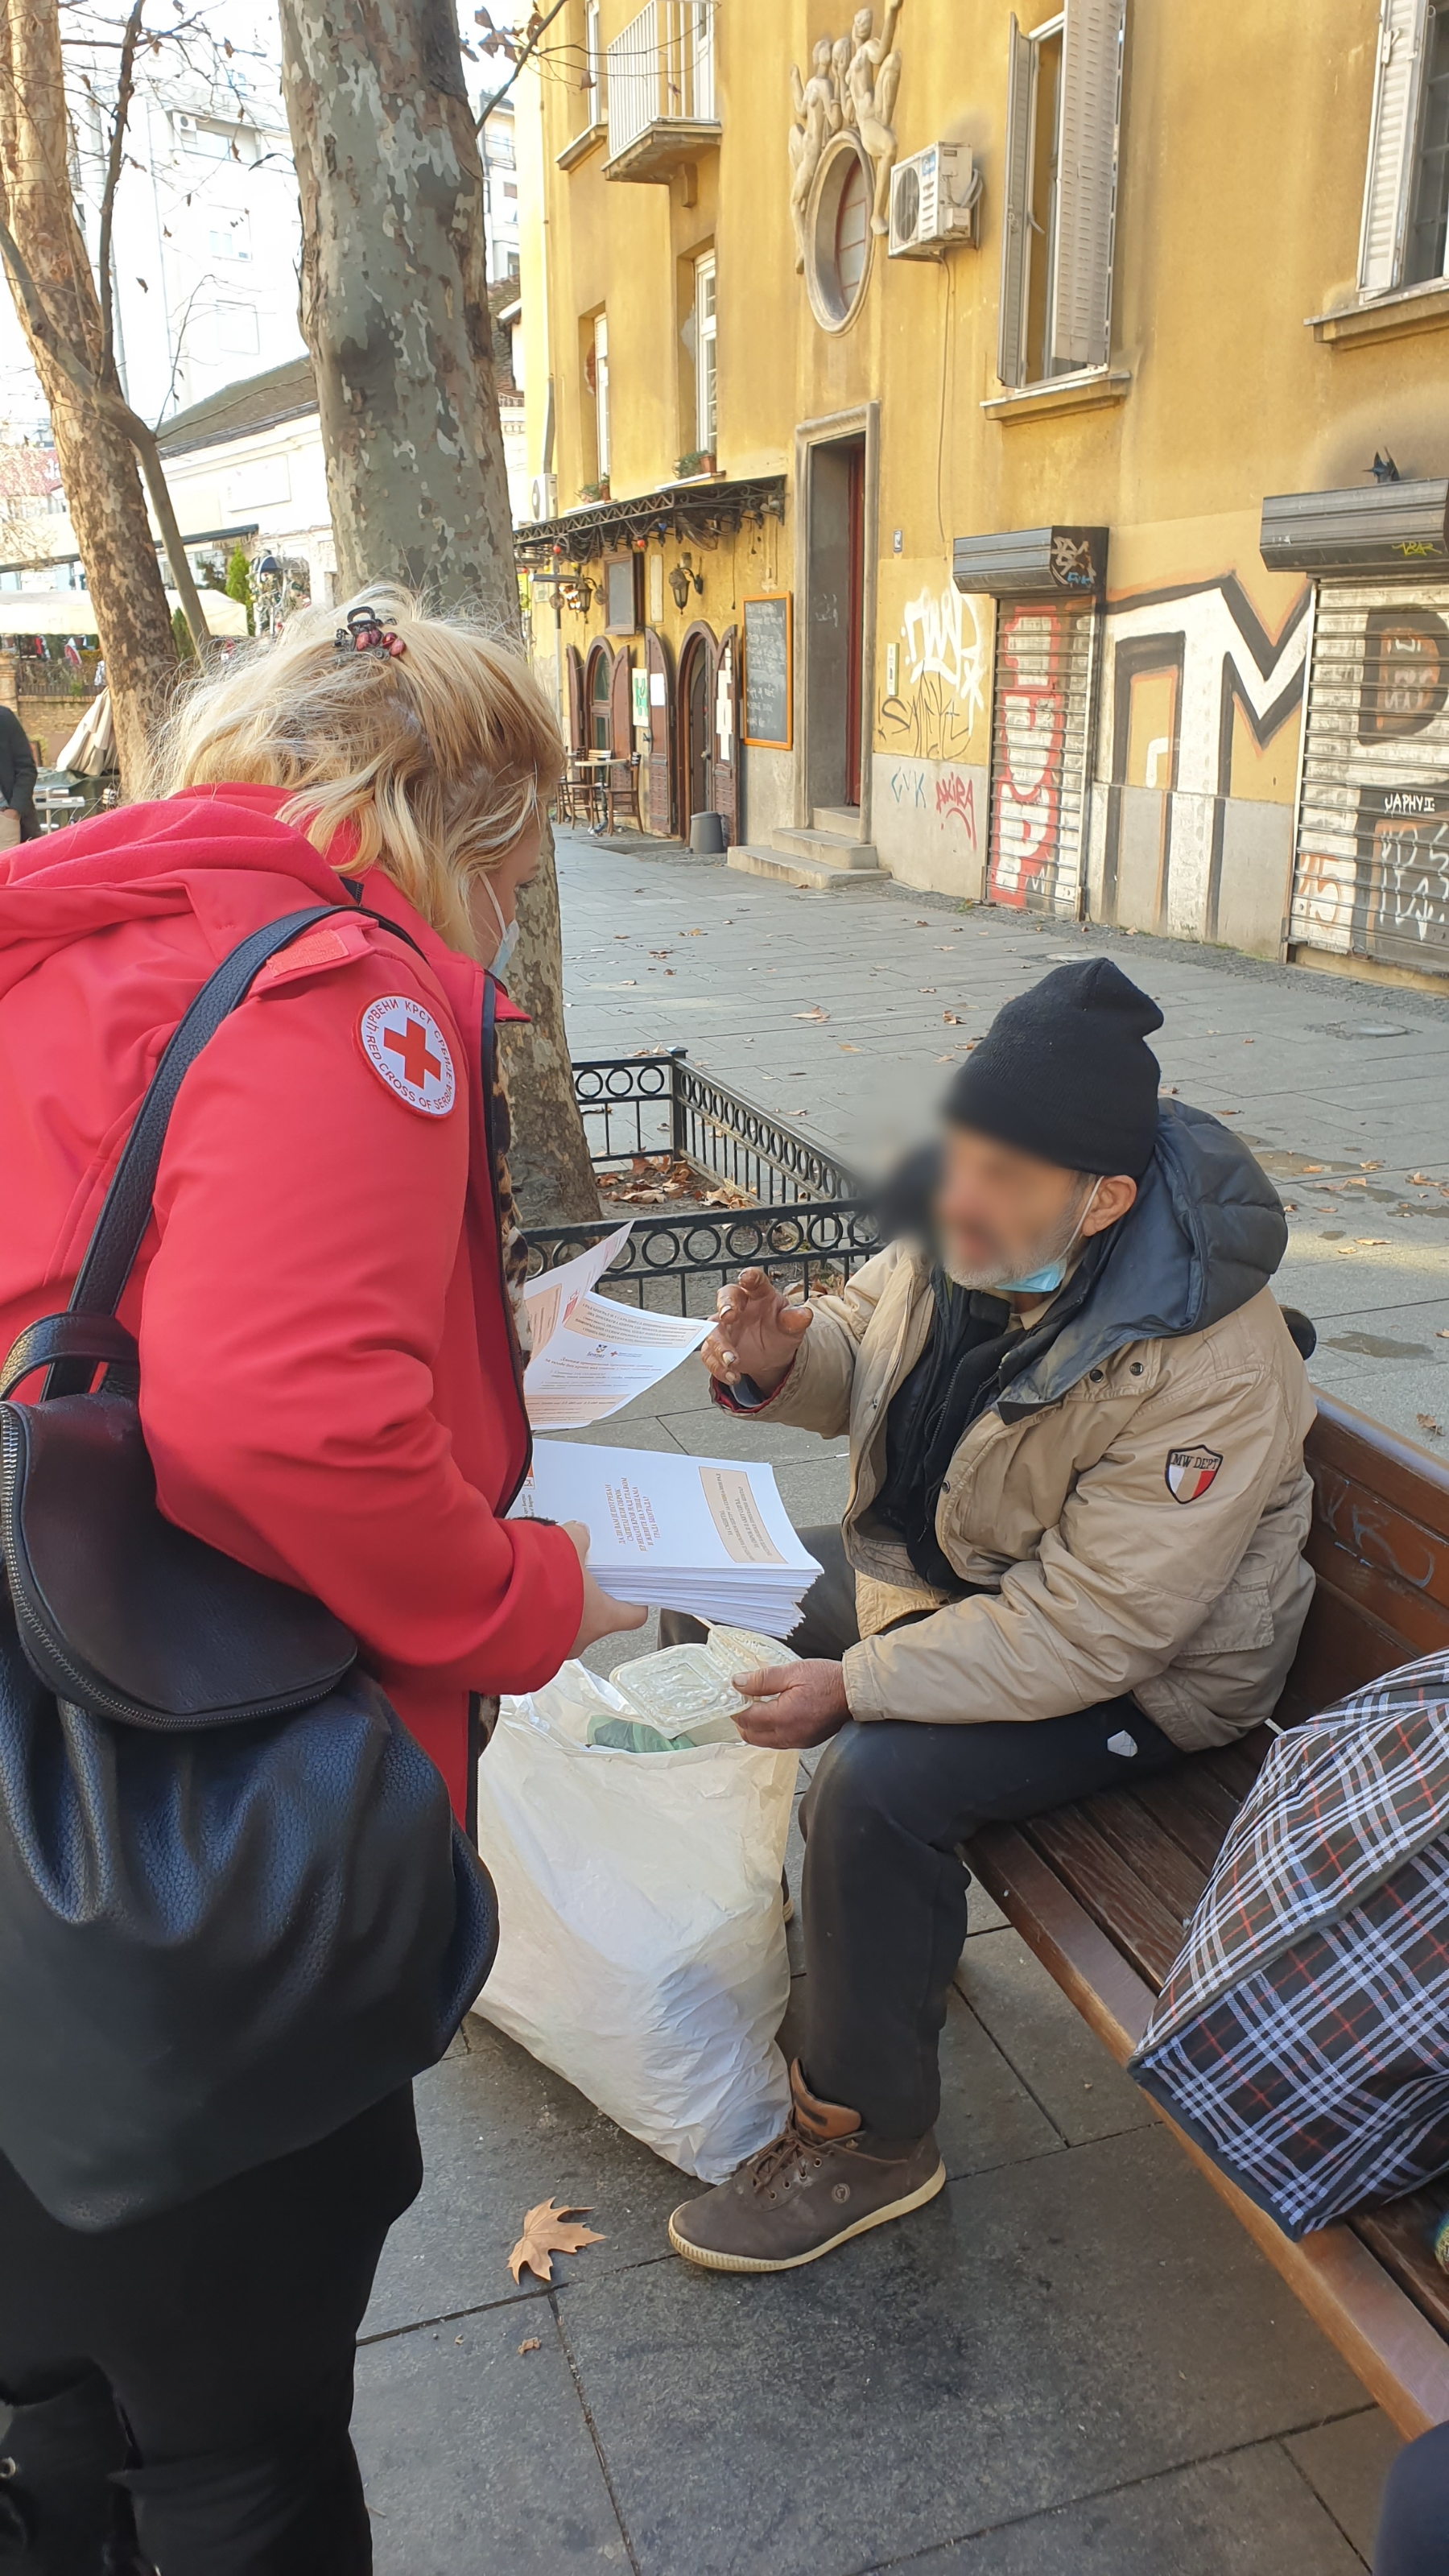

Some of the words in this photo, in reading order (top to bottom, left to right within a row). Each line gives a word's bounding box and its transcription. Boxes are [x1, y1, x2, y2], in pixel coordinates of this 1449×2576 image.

[365, 999, 399, 1034] ЦРВЕНИ
[404, 1001, 431, 1025] КРСТ
[434, 1030, 452, 1080] СРБИЈЕ
[366, 1034, 382, 1060] RED
[379, 1063, 415, 1102] CROSS
[419, 1097, 431, 1109] OF
[433, 1085, 452, 1109] SERBIA
[1170, 1453, 1194, 1468] MW
[1193, 1457, 1219, 1469] DEPT
